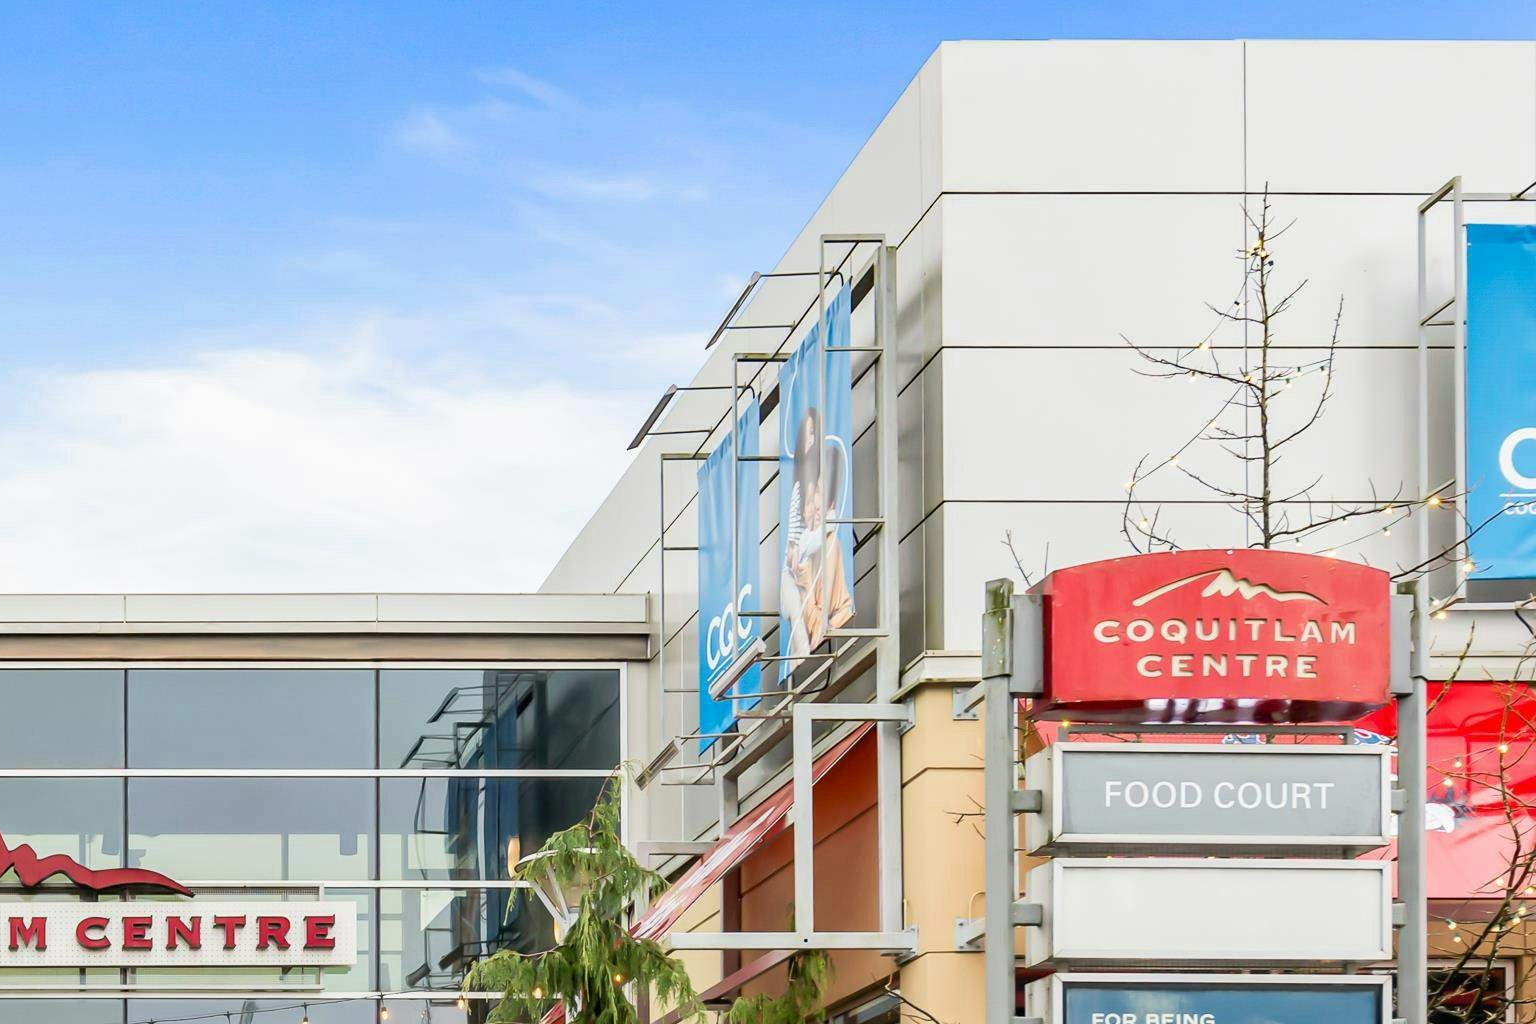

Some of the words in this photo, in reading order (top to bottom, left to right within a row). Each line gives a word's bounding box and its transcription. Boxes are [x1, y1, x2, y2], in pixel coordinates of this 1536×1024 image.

[1093, 618, 1357, 645] COQUITLAM
[1136, 653, 1318, 679] CENTRE
[1105, 781, 1203, 808] FOOD
[1213, 781, 1335, 809] COURT
[75, 915, 337, 952] CENTRE
